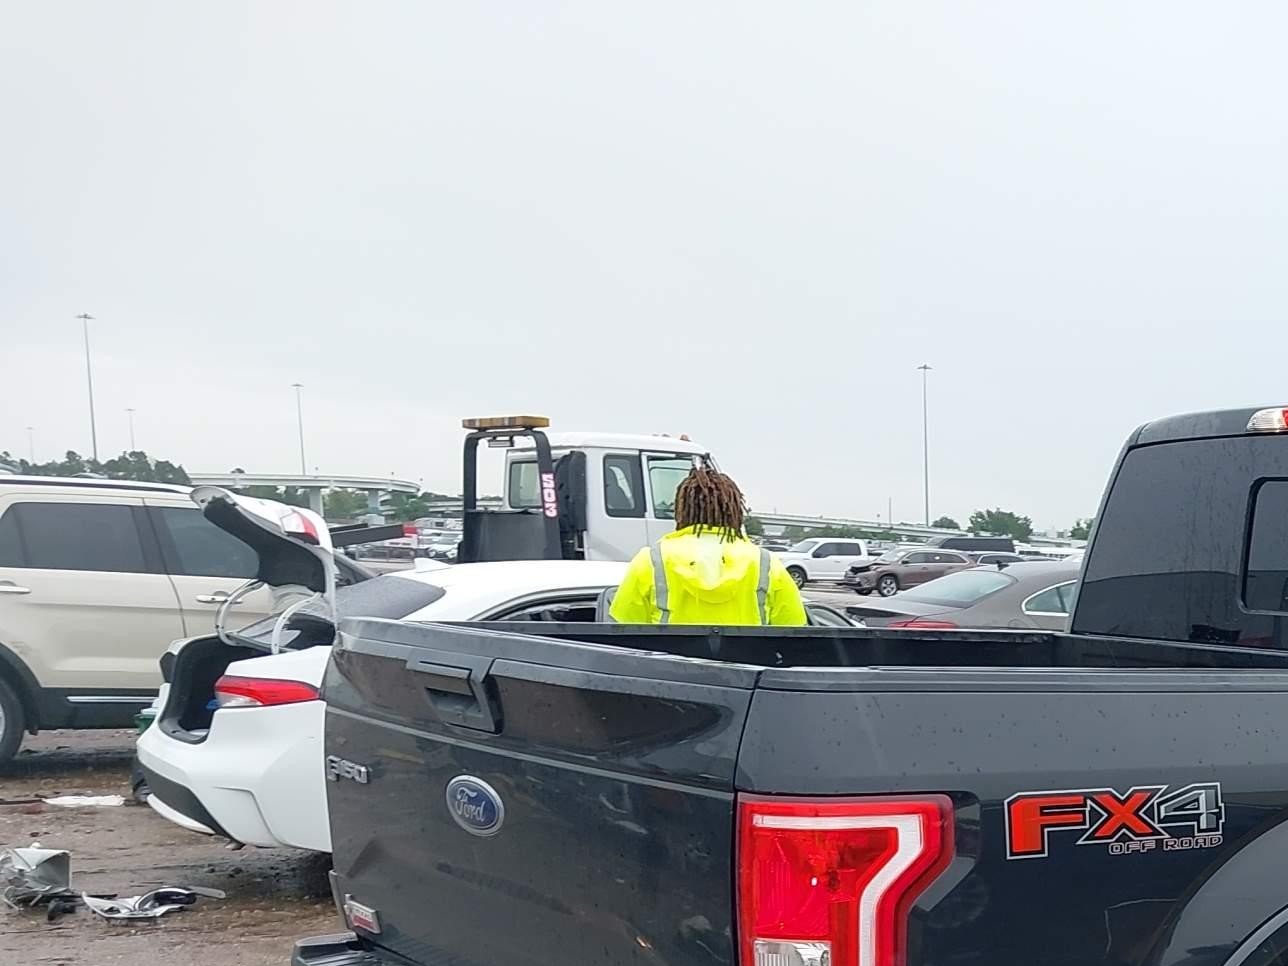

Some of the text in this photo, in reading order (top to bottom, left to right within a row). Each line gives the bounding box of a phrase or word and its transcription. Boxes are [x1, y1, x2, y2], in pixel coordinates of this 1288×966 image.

[541, 472, 558, 517] 503
[1003, 782, 1224, 860] FX4
[1108, 834, 1224, 856] OFF ROAD
